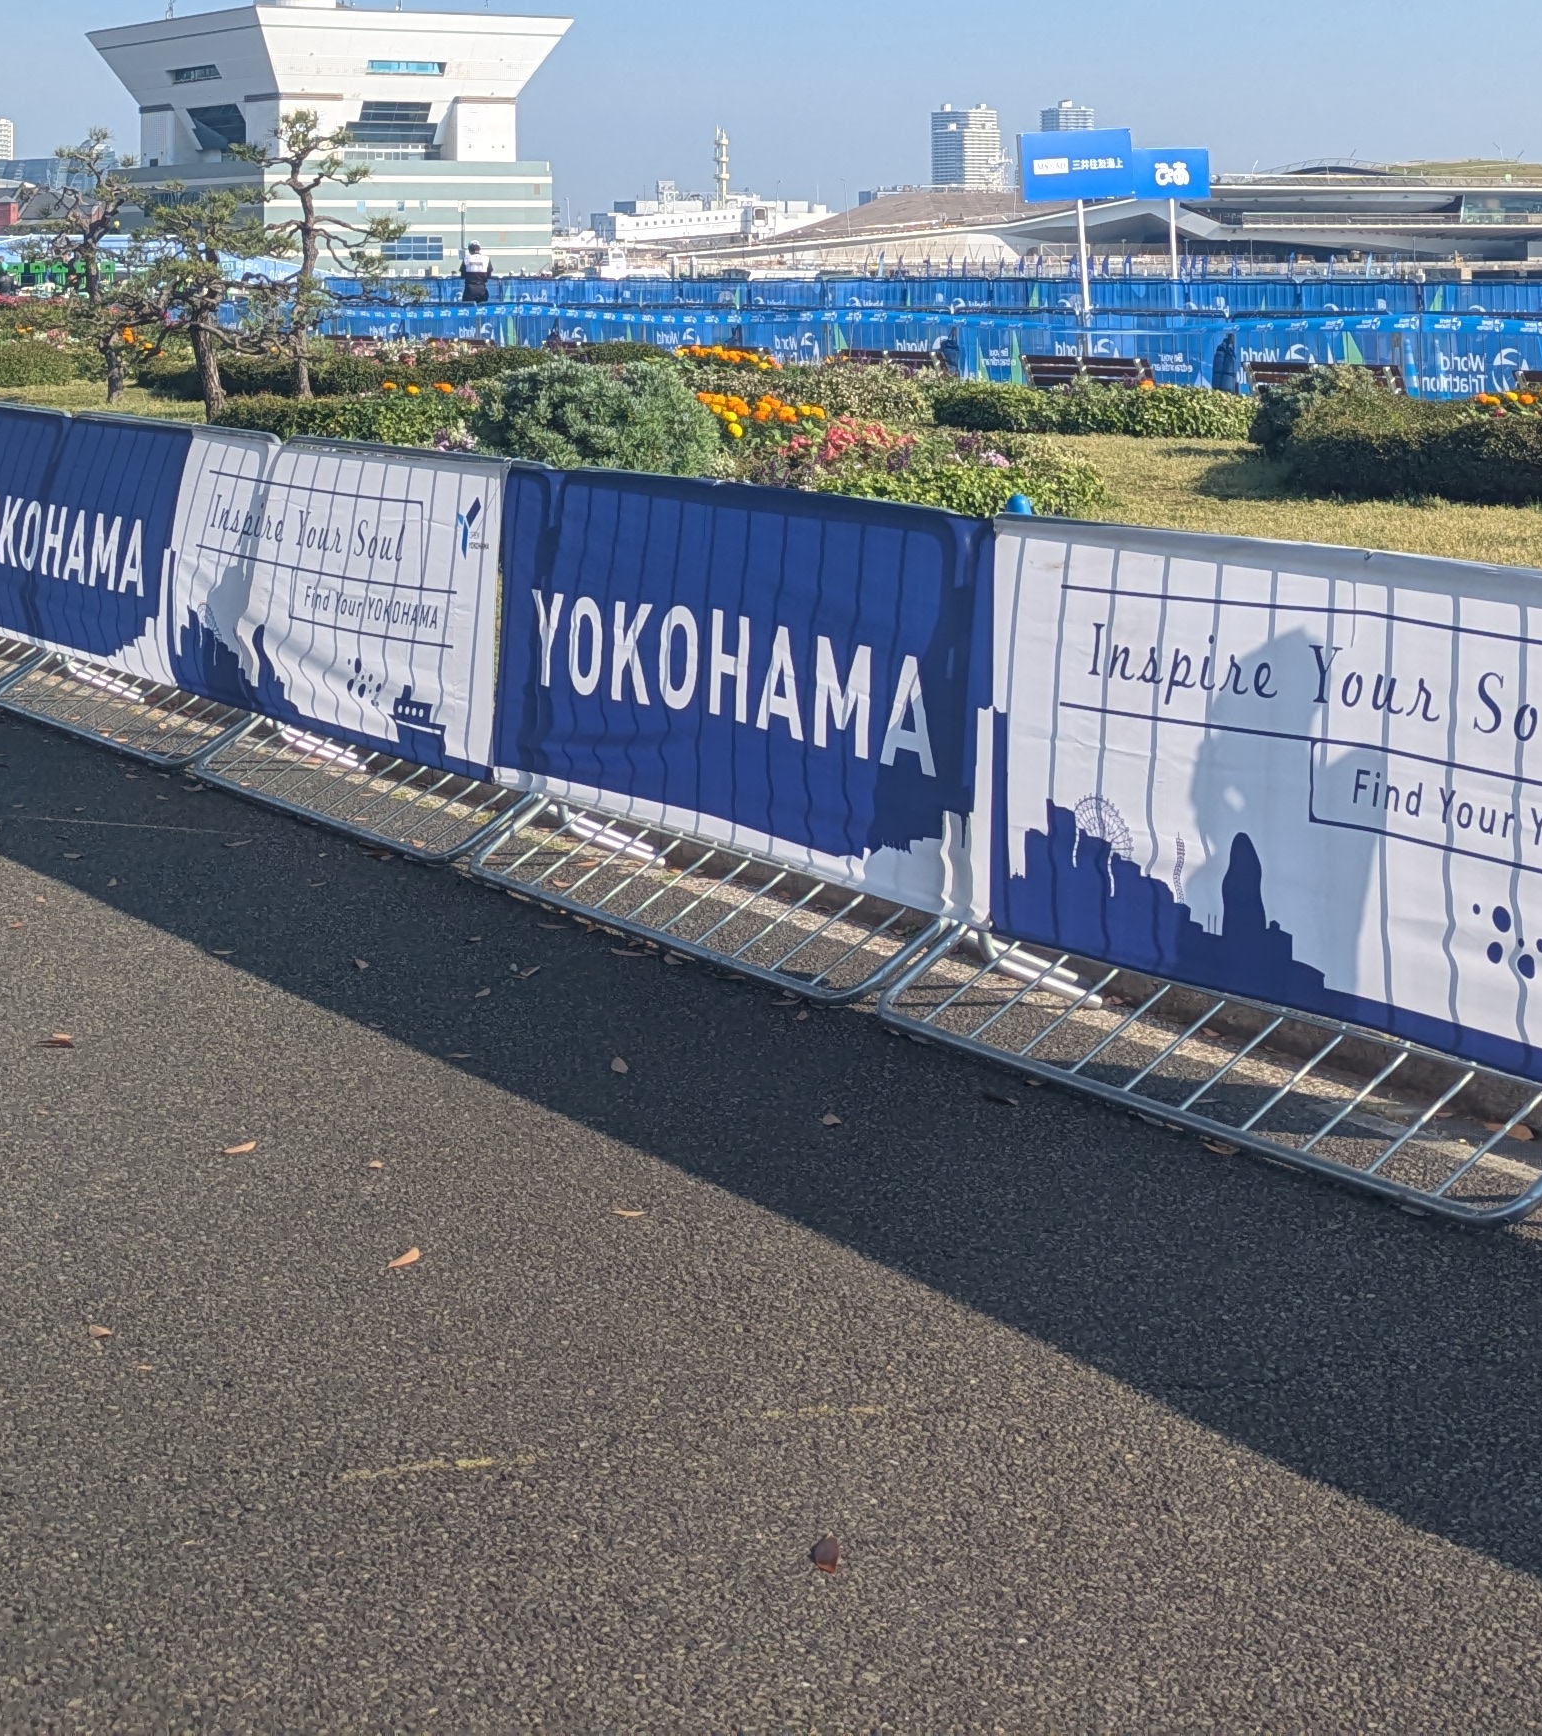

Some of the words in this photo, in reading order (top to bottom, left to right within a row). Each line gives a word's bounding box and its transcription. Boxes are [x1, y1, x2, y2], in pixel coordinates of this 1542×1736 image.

[209, 493, 284, 547] Inspire
[295, 509, 343, 554] Your
[352, 519, 406, 563] Soul
[304, 586, 330, 613] Find
[335, 592, 363, 619] Your
[365, 596, 439, 630] YOKOHAMA
[531, 588, 937, 778] YOKOHAMA
[1087, 622, 1279, 705] Inspire
[1308, 643, 1441, 723] Your
[1352, 769, 1424, 818] Find
[1438, 787, 1519, 840] Your
